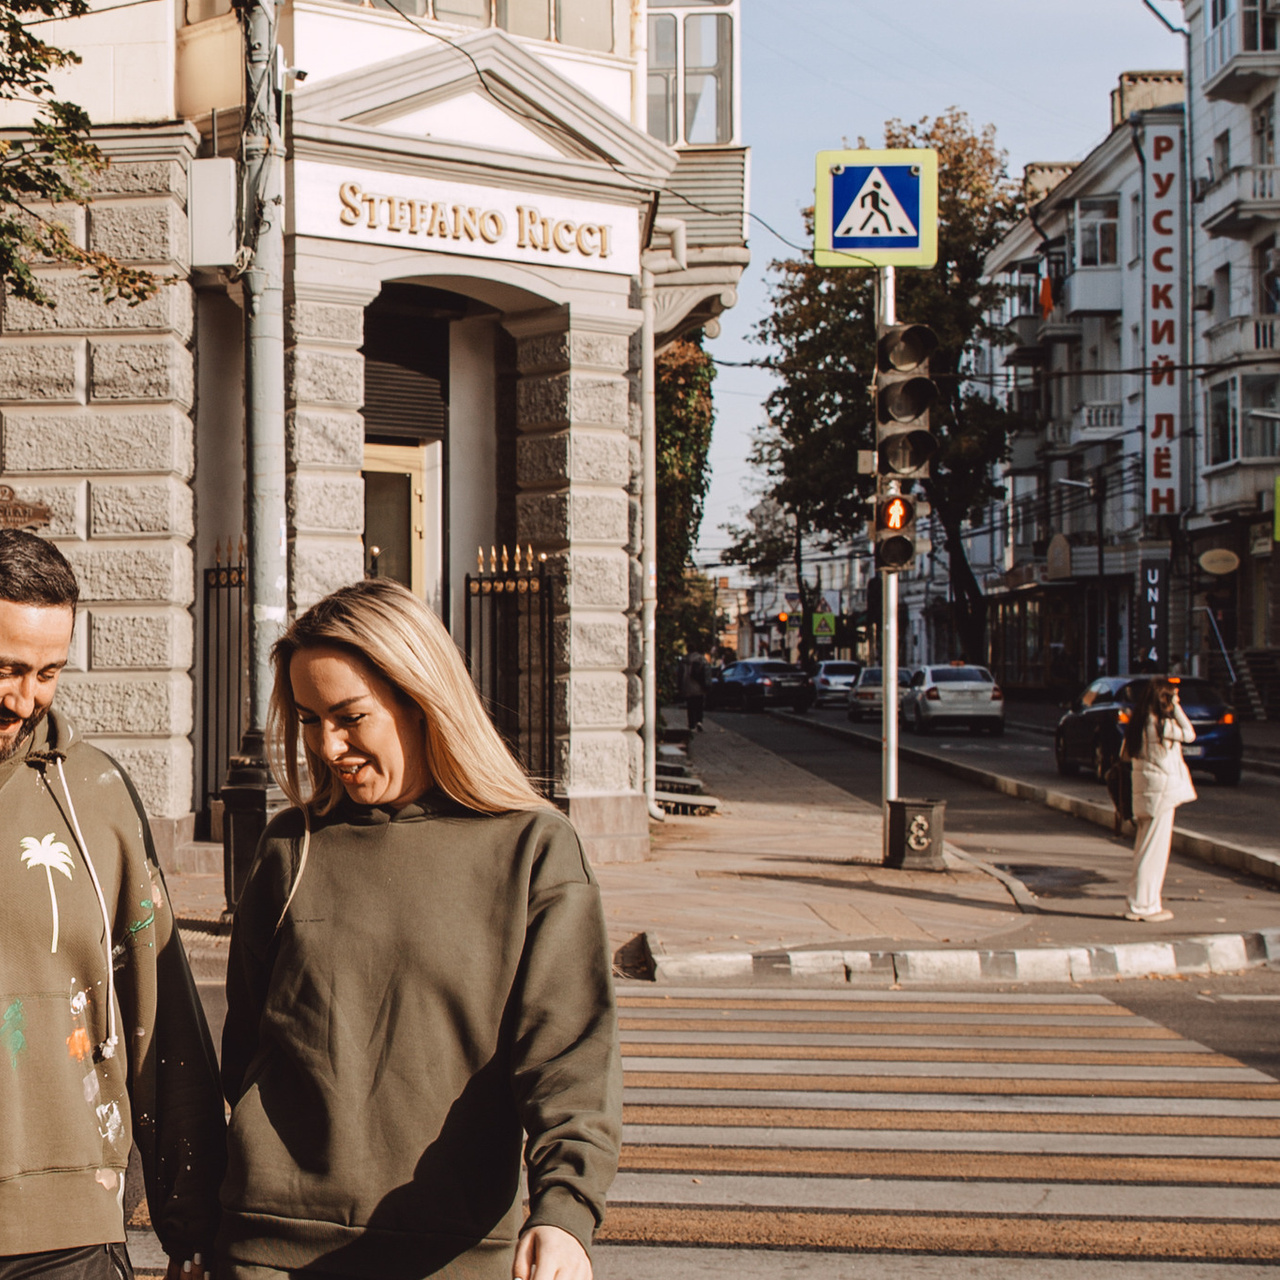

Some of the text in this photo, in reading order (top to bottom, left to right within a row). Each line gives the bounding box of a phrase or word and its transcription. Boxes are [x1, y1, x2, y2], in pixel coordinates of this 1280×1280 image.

[1151, 135, 1175, 513] РУССКИЙ ЛЁН
[1147, 568, 1159, 639] UNIT
